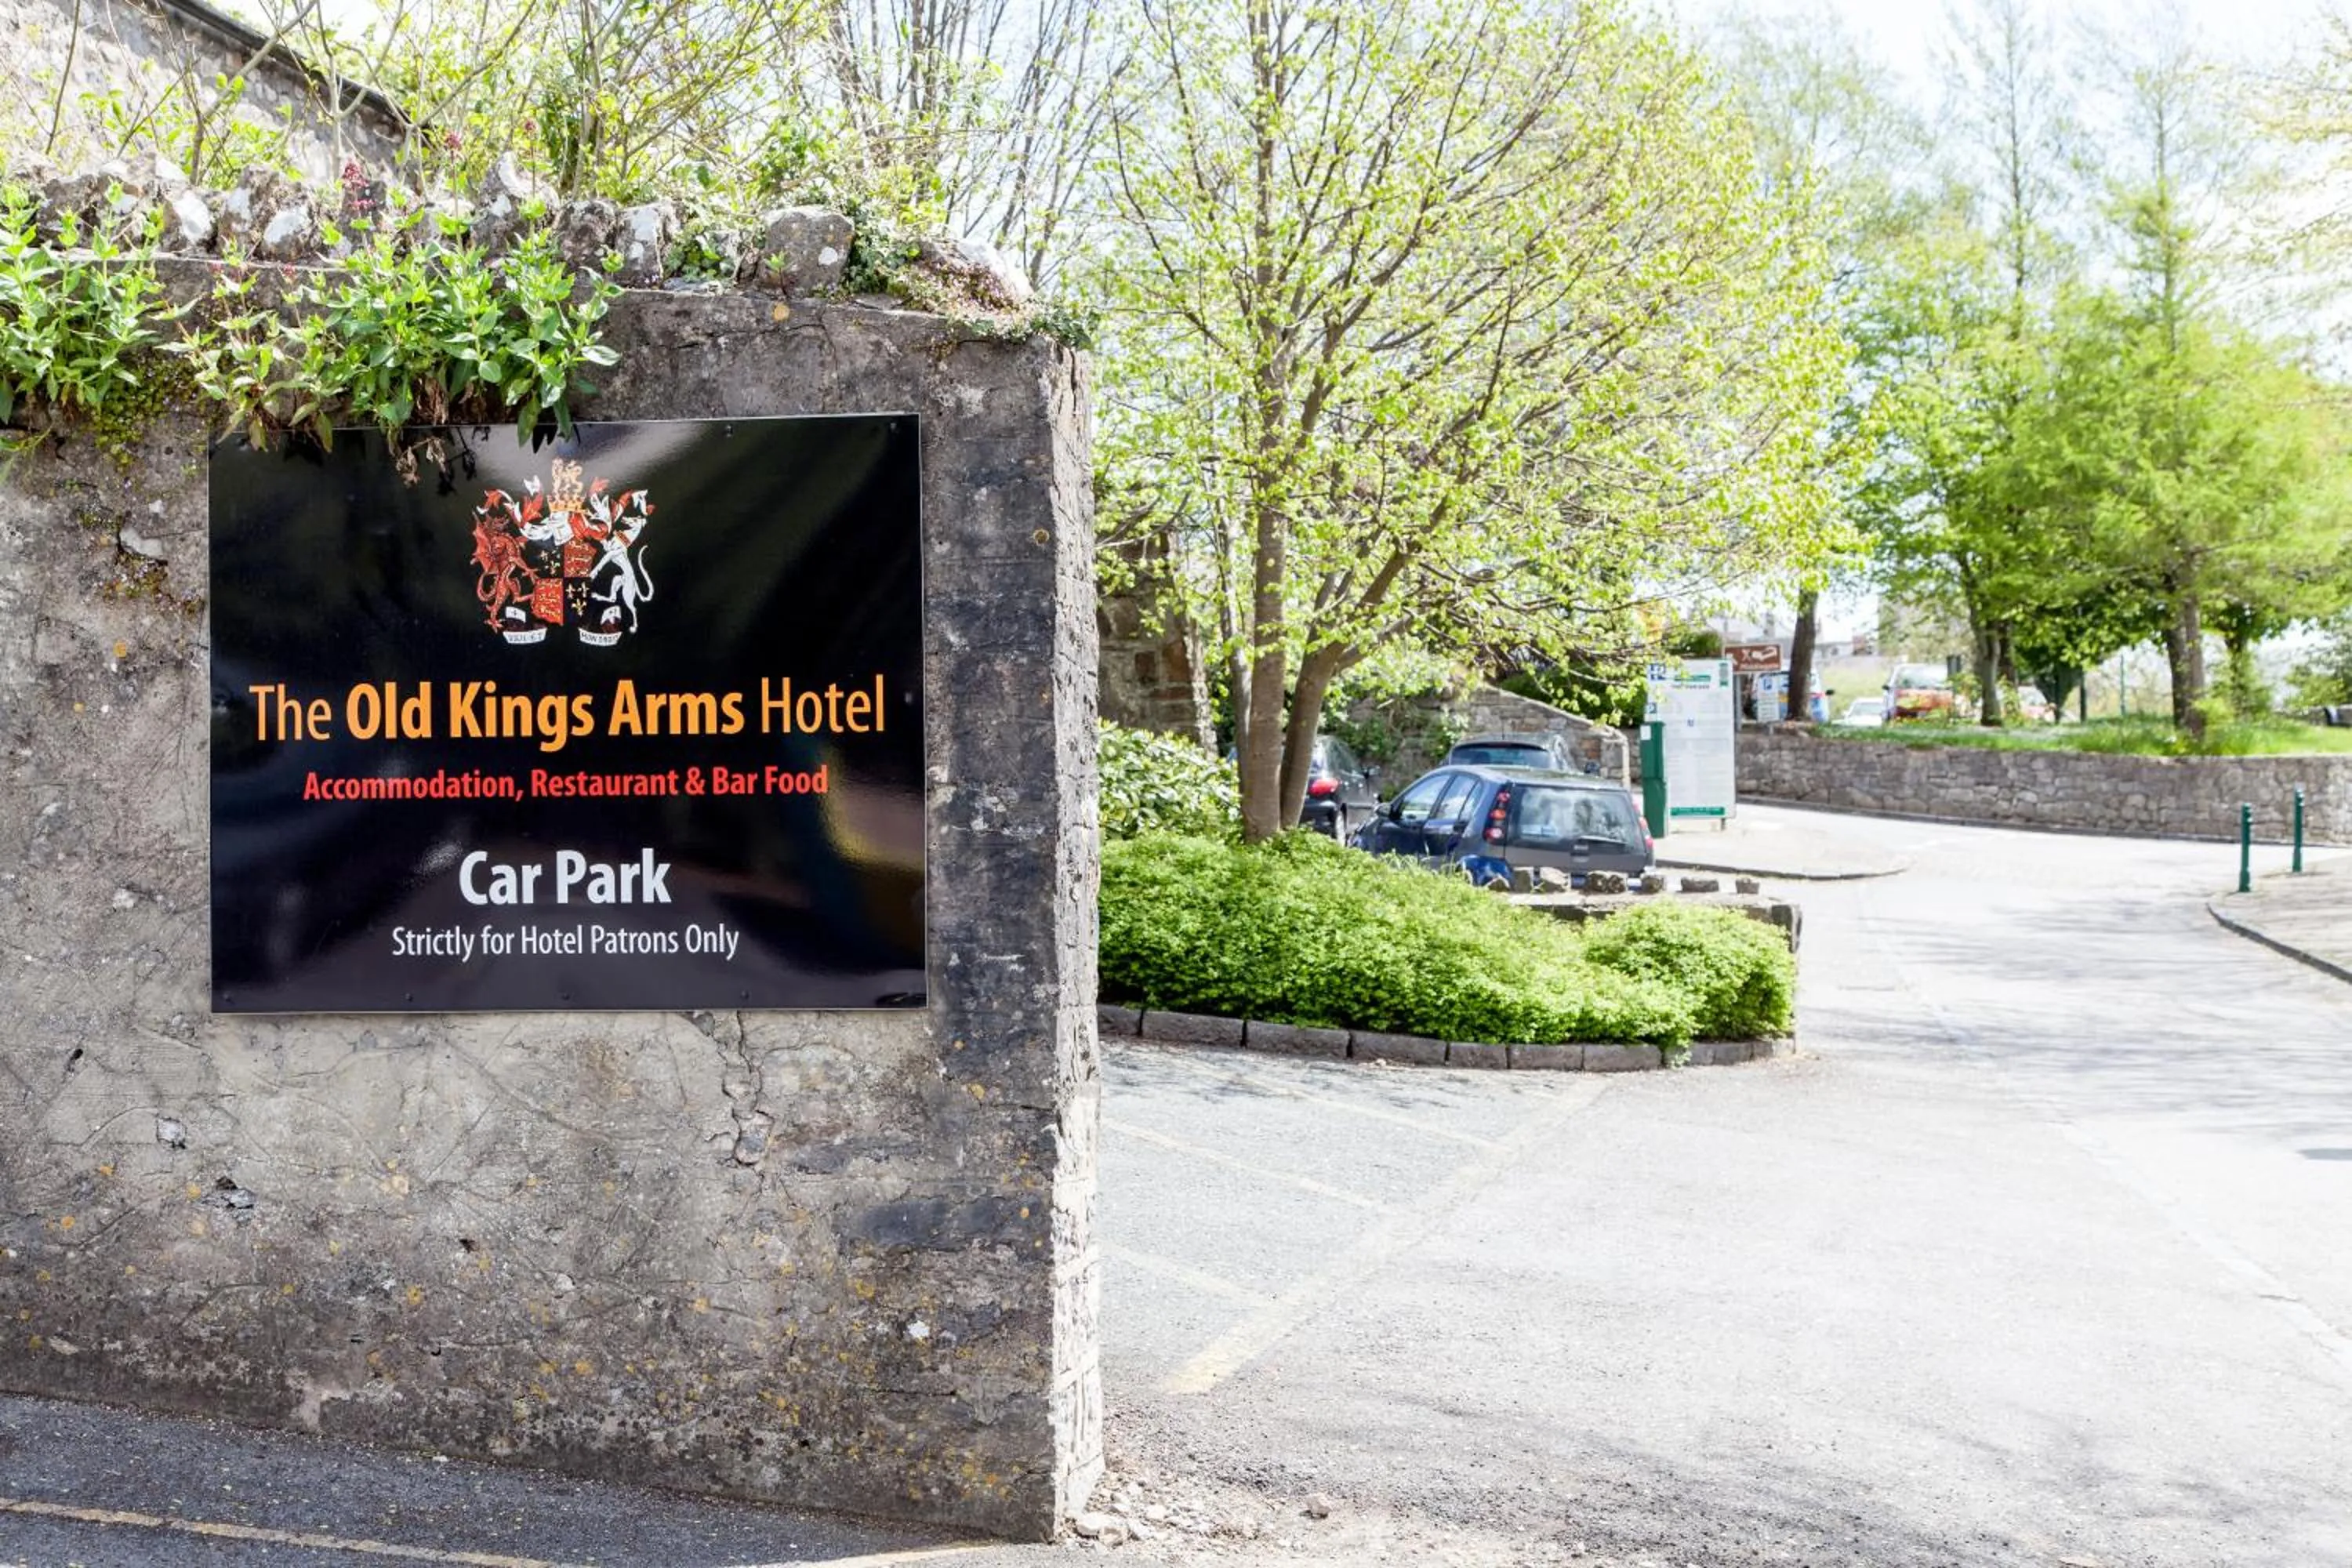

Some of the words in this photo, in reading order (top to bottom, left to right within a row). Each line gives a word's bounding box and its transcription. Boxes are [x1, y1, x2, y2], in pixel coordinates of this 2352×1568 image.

[249, 684, 332, 742] The
[346, 681, 433, 740] Old
[449, 679, 595, 753] Kings
[608, 679, 745, 736] Arms
[760, 674, 884, 734] Hotel
[303, 769, 524, 801] Accommodation,
[531, 768, 679, 797] Restaurant
[684, 767, 706, 795] &
[713, 766, 758, 795] Bar
[764, 764, 829, 795] Food
[459, 851, 542, 906] Car
[556, 848, 672, 904] Park
[392, 925, 475, 963] Strictly
[481, 924, 515, 955] for
[521, 924, 583, 955] Hotel
[590, 924, 680, 954] Patrons
[684, 923, 740, 961] Only
